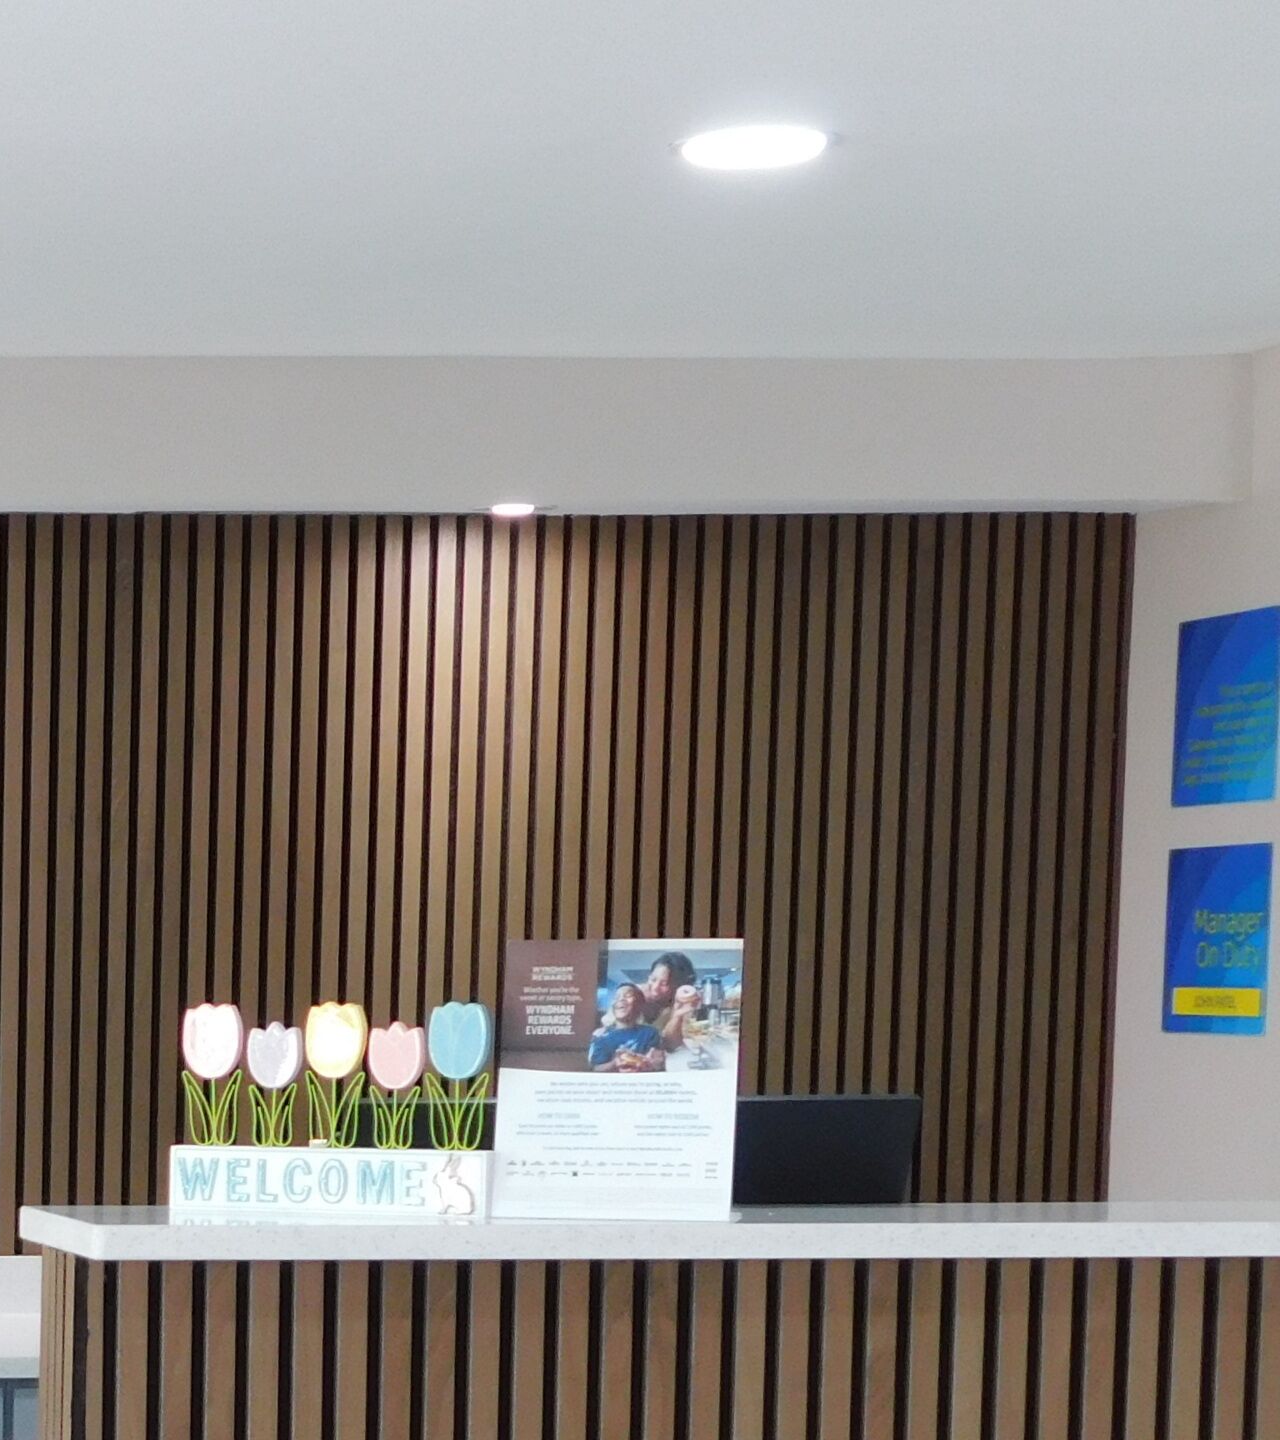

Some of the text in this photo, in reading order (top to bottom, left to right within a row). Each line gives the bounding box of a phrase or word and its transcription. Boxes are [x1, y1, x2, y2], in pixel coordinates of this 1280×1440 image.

[1194, 909, 1264, 941] Manager
[1197, 942, 1218, 968] On
[525, 1005, 575, 1014] WYNDHAM
[527, 1015, 572, 1024] REWARDS
[525, 1025, 576, 1035] EVERYONE.
[176, 1156, 428, 1208] WELCOME
